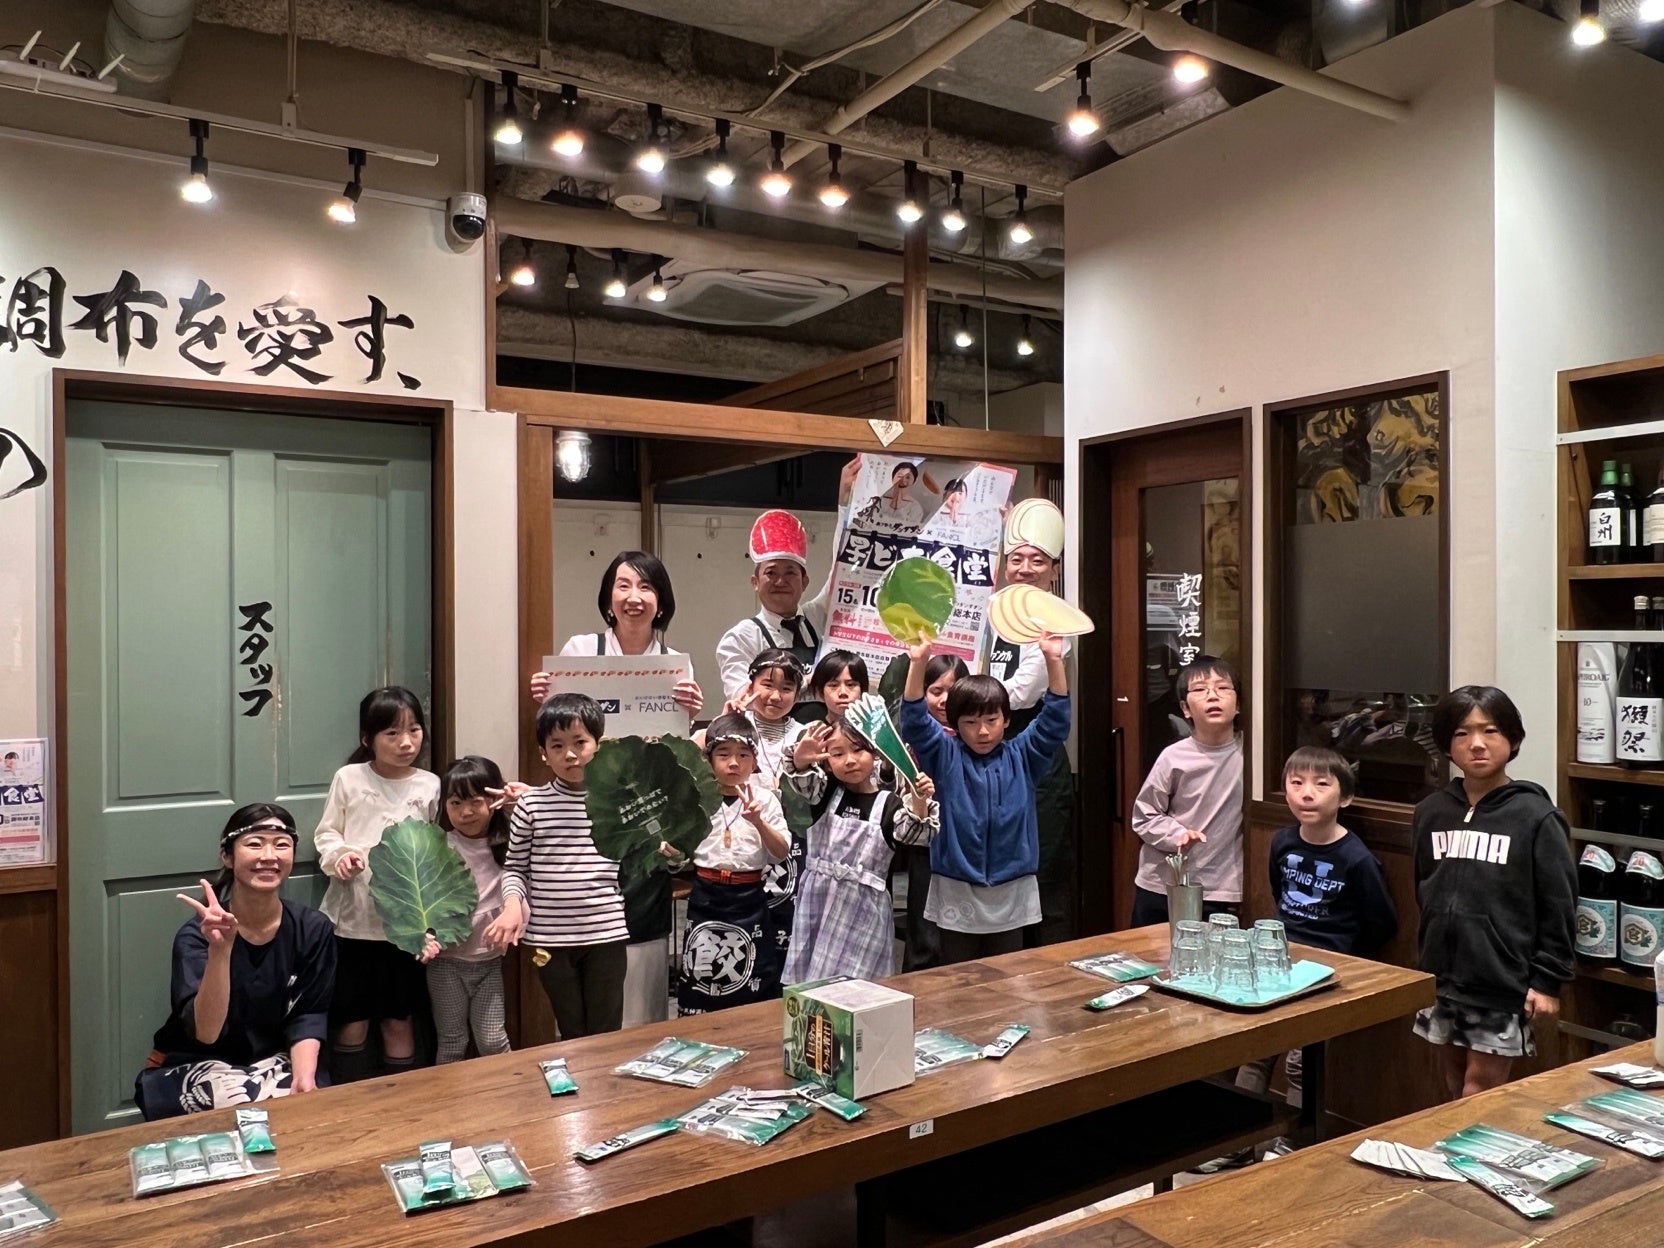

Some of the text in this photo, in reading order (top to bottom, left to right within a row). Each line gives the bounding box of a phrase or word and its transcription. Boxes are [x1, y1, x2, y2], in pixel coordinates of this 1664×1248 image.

[1598, 512, 1613, 541] 白州
[1176, 572, 1203, 666] 喫煙室
[238, 601, 274, 717] スタッフ
[639, 701, 679, 712] FANCL
[1431, 830, 1511, 865] PUMA
[1314, 877, 1345, 893] DEPT
[915, 1123, 928, 1134] 42
